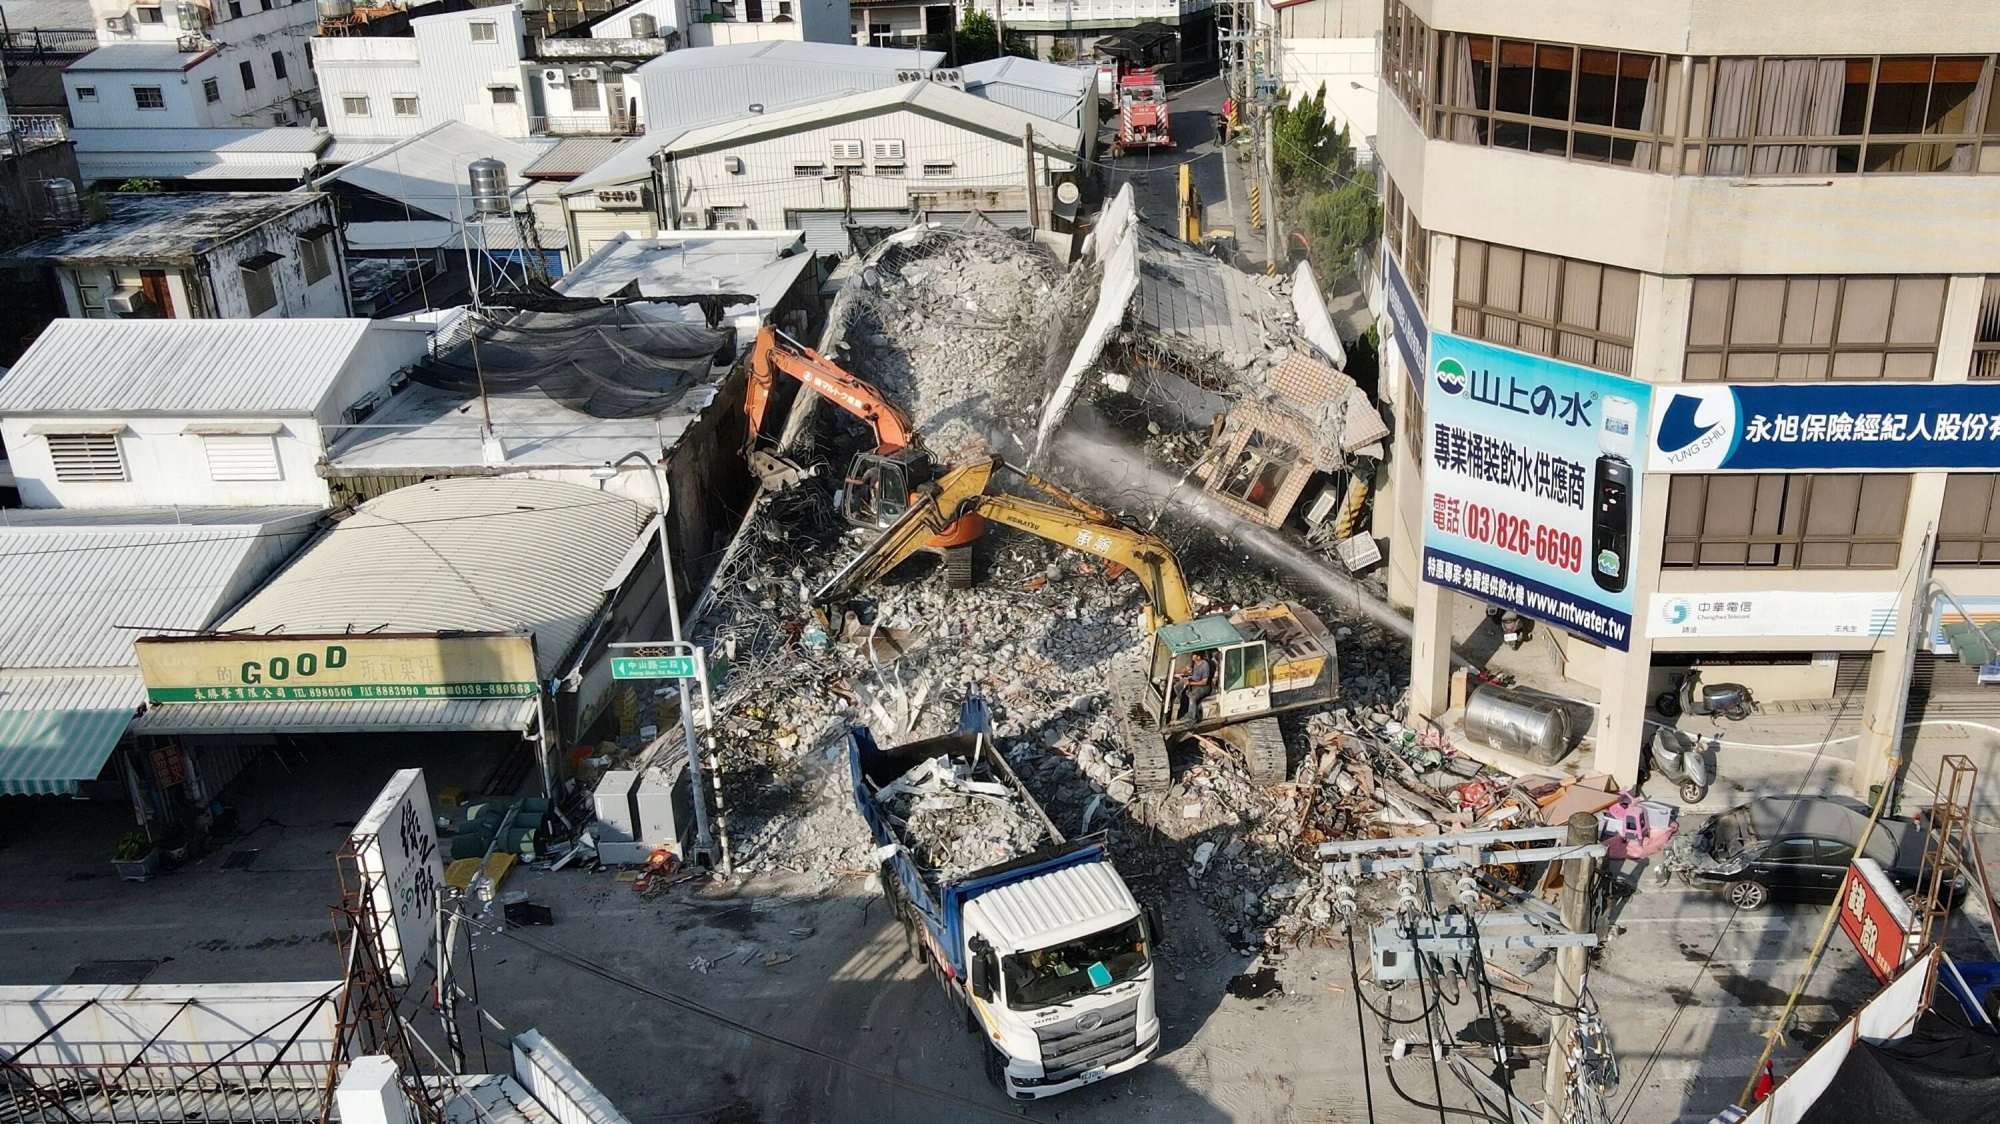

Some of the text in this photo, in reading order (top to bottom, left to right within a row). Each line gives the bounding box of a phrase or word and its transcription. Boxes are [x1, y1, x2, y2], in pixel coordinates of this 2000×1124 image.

[1470, 369, 1594, 428] 山上の水
[1667, 425, 1726, 465] YUNG SHIU
[1434, 423, 1586, 511] 專業桶裝飲水供應商
[1006, 515, 1041, 531] KOMATSU
[1526, 589, 1626, 642] www.mtwater.tw
[1697, 601, 1753, 613] 中華電信
[1834, 625, 1858, 633] 王先生
[241, 645, 348, 685] GOOD
[628, 660, 679, 670] 中山路二段
[1034, 1015, 1060, 1025] HINO
